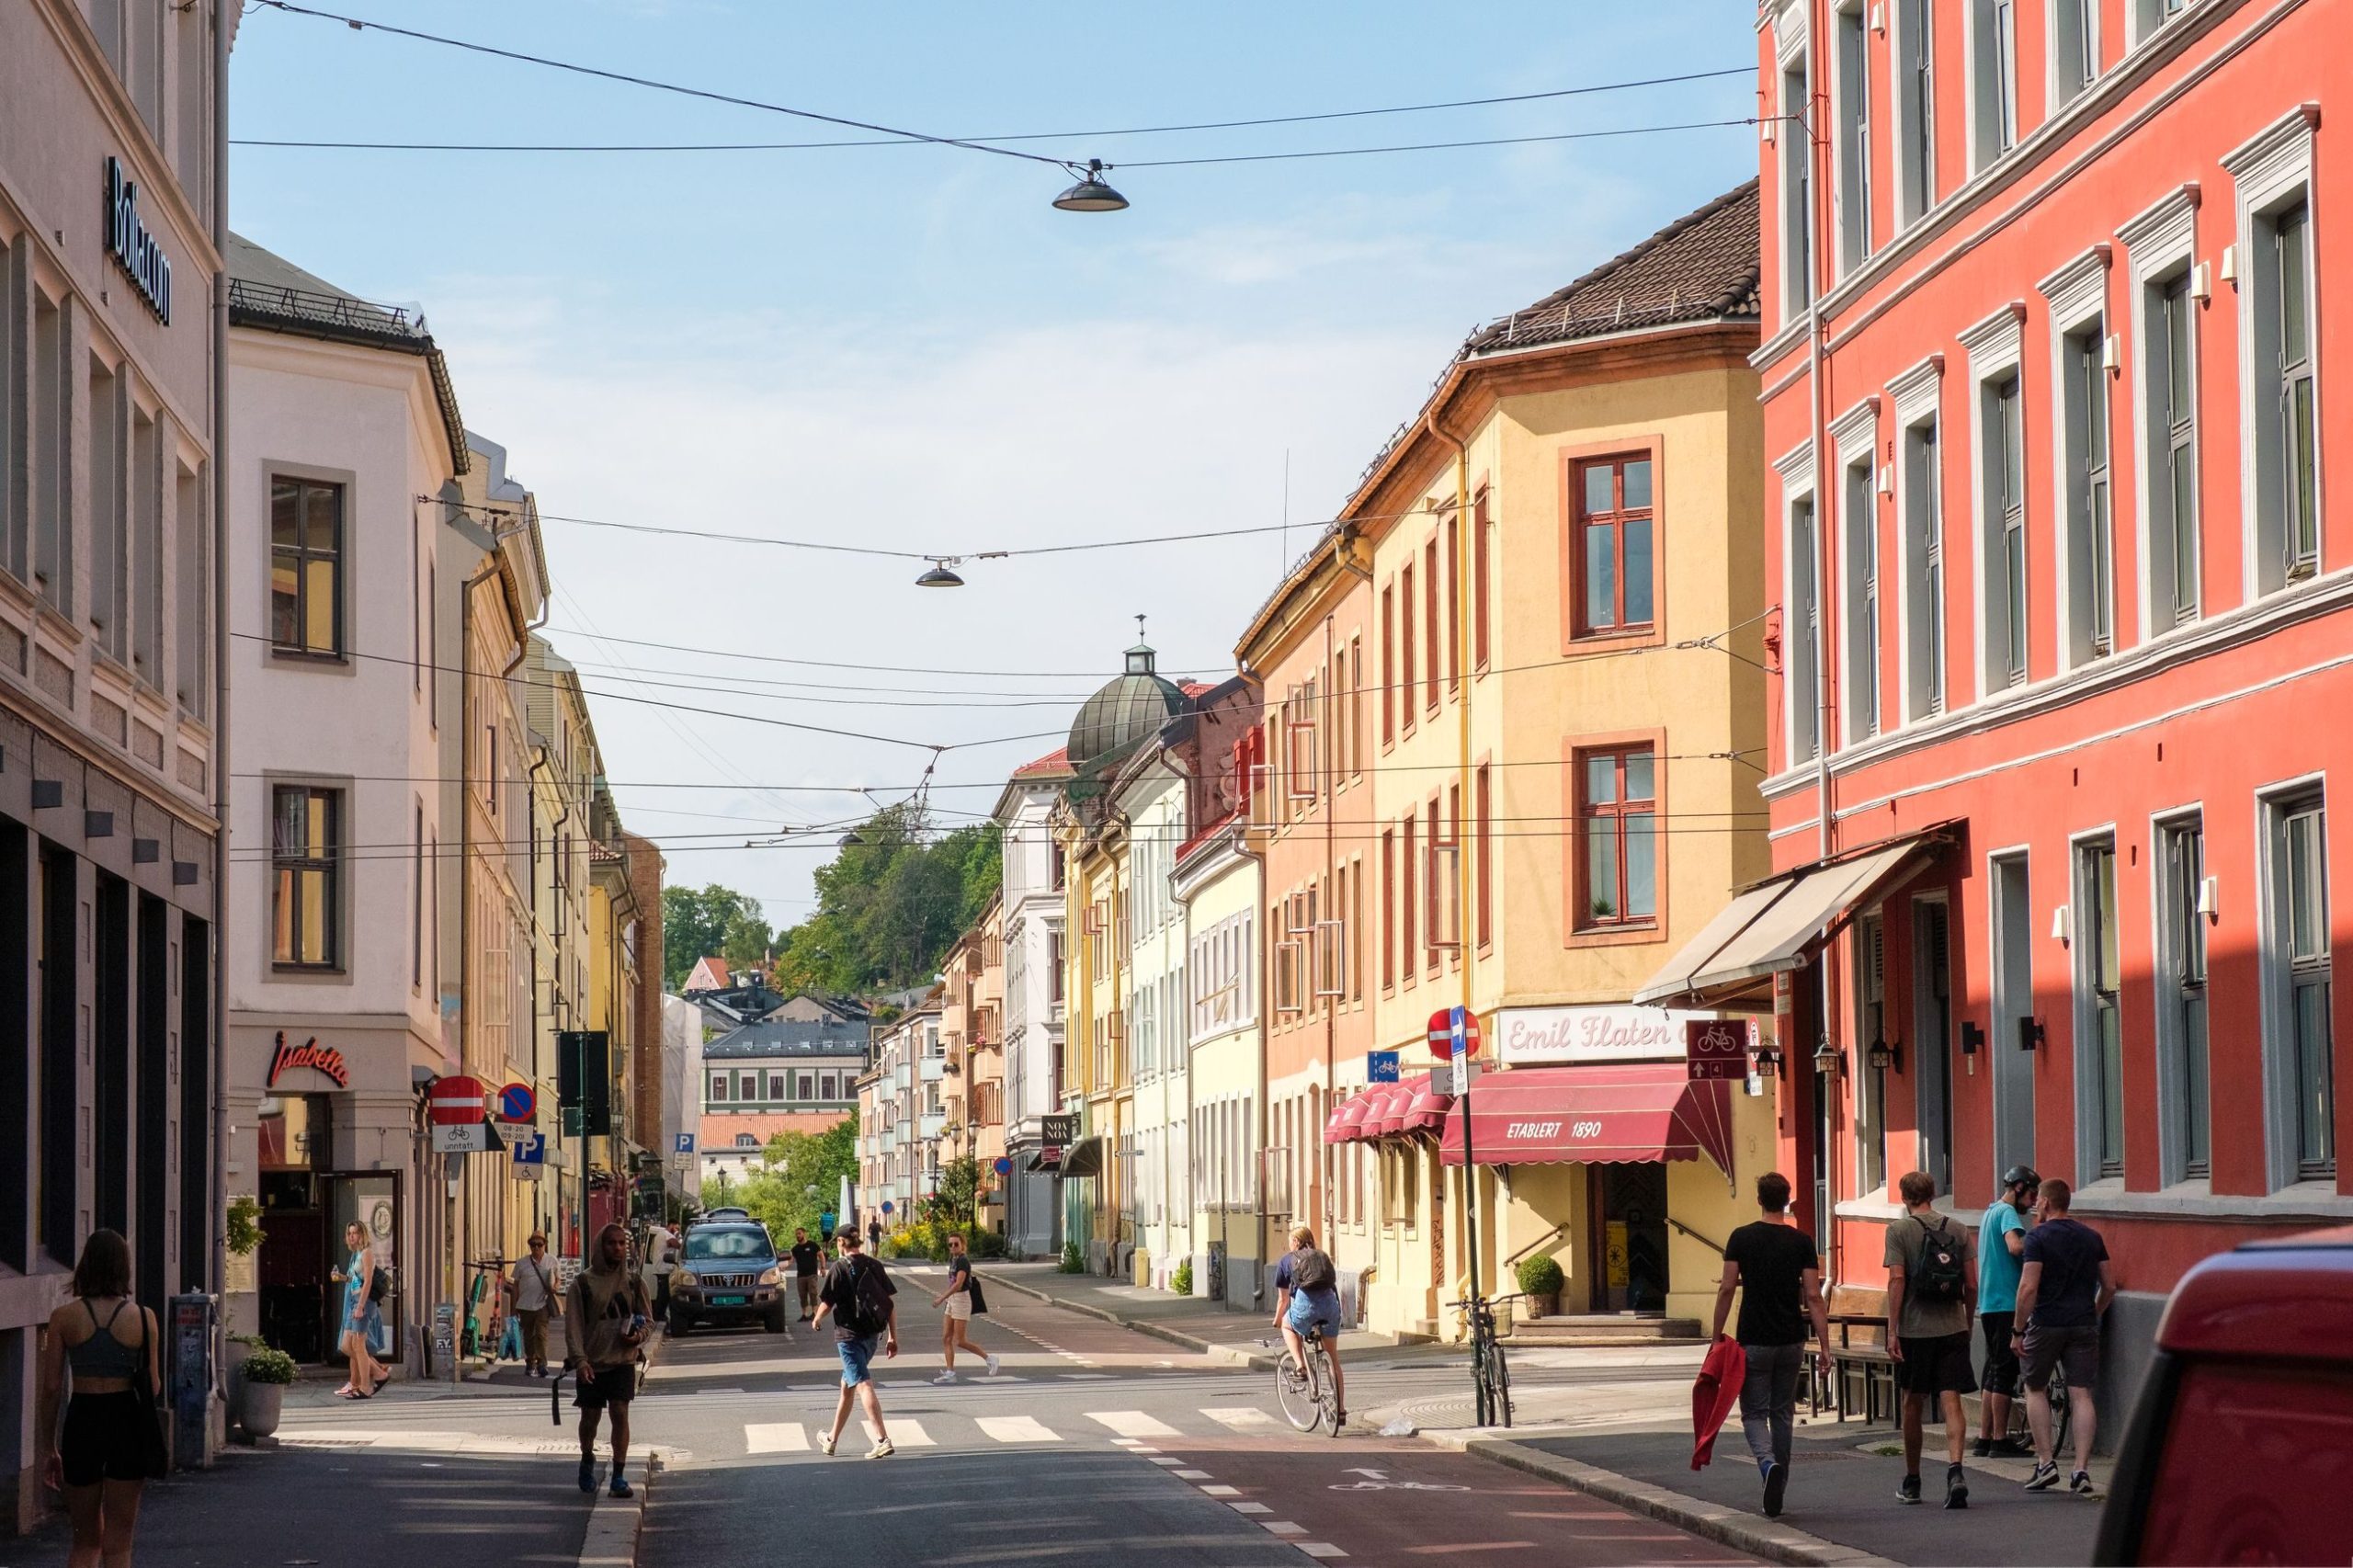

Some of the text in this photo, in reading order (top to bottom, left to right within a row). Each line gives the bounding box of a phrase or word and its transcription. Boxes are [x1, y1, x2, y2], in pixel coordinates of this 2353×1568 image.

[109, 156, 172, 326] Bolia.com
[1508, 1017, 1570, 1050] Emil
[1581, 1016, 1671, 1047] Flaten
[267, 1030, 349, 1088] Isabella
[1047, 1121, 1067, 1131] NOA
[1047, 1131, 1067, 1139] NOA
[1507, 1121, 1602, 1139] ETABLERT 1890
[444, 1142, 474, 1151] unntatt
[521, 1137, 538, 1160] P
[679, 1135, 690, 1151] P
